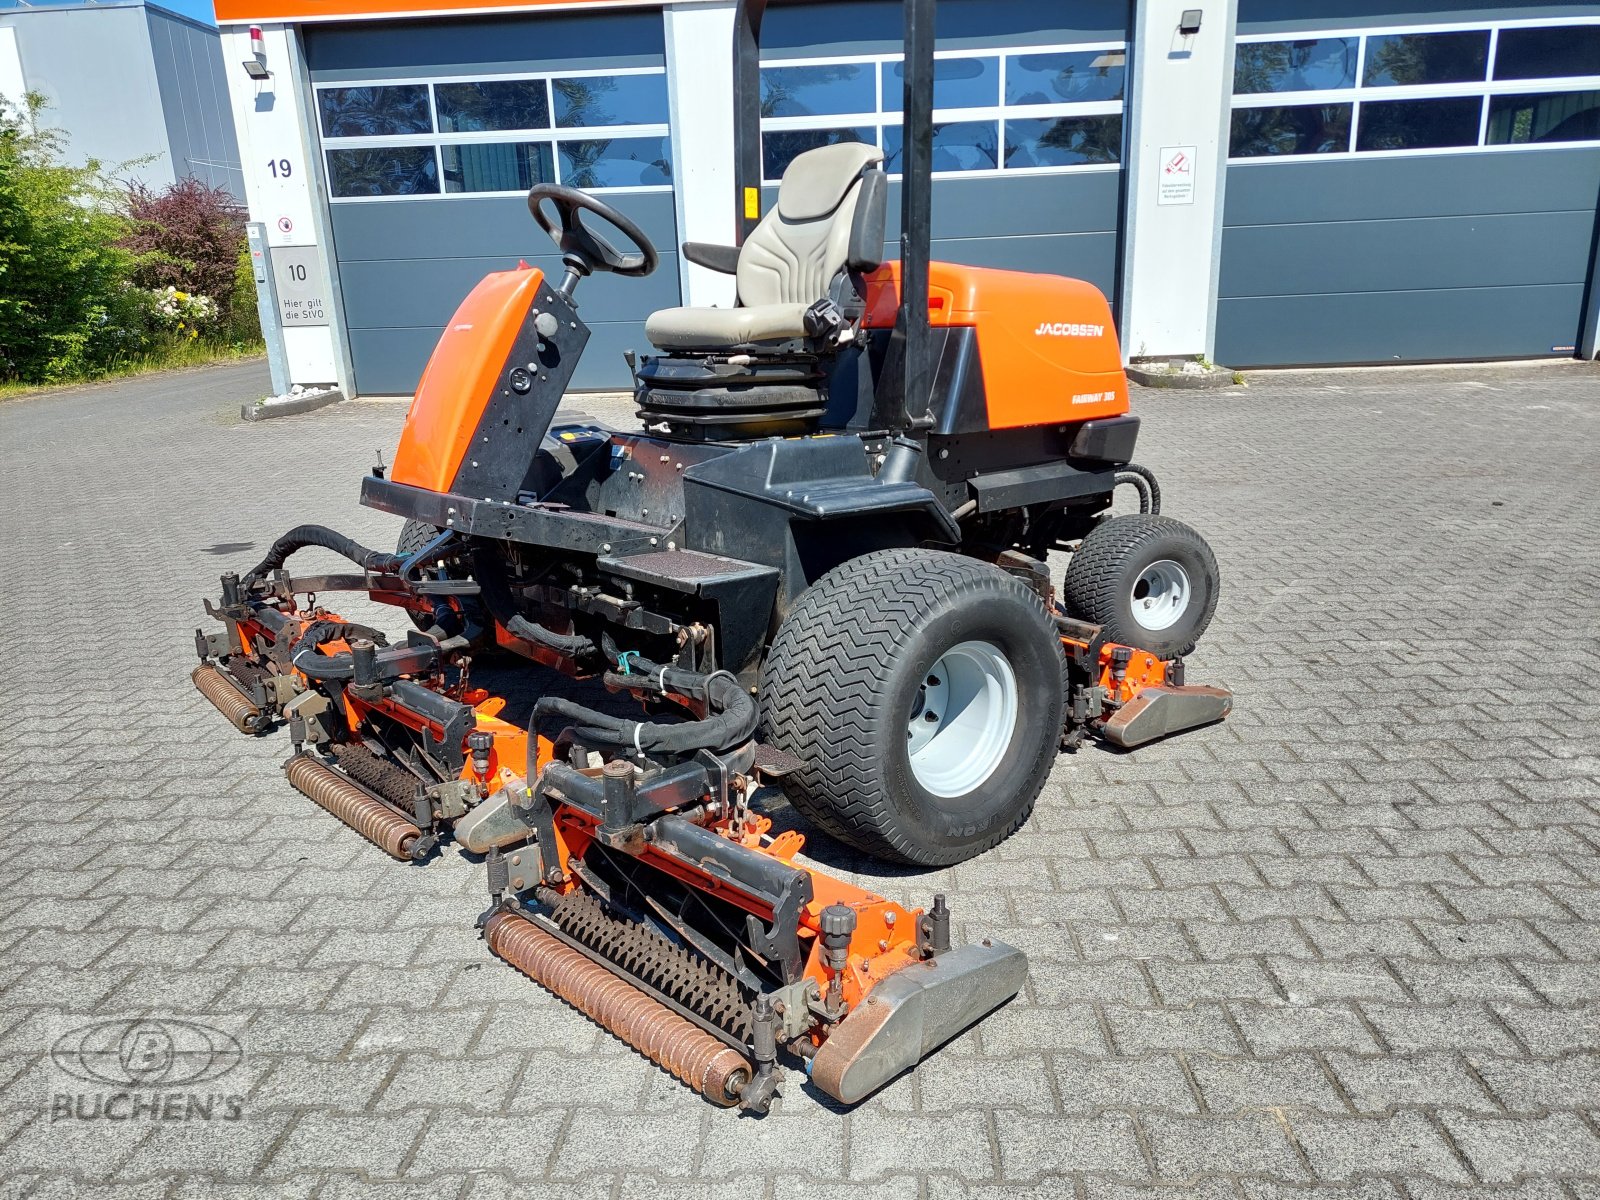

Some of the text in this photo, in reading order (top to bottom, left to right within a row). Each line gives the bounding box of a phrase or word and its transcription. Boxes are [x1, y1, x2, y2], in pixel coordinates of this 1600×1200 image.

[267, 158, 292, 178] 19
[288, 264, 307, 282] 10
[283, 298, 322, 310] Hier gilt
[285, 309, 324, 319] die StVO
[1034, 322, 1104, 337] JACOBSEN
[1071, 392, 1103, 404] FAIRWAY
